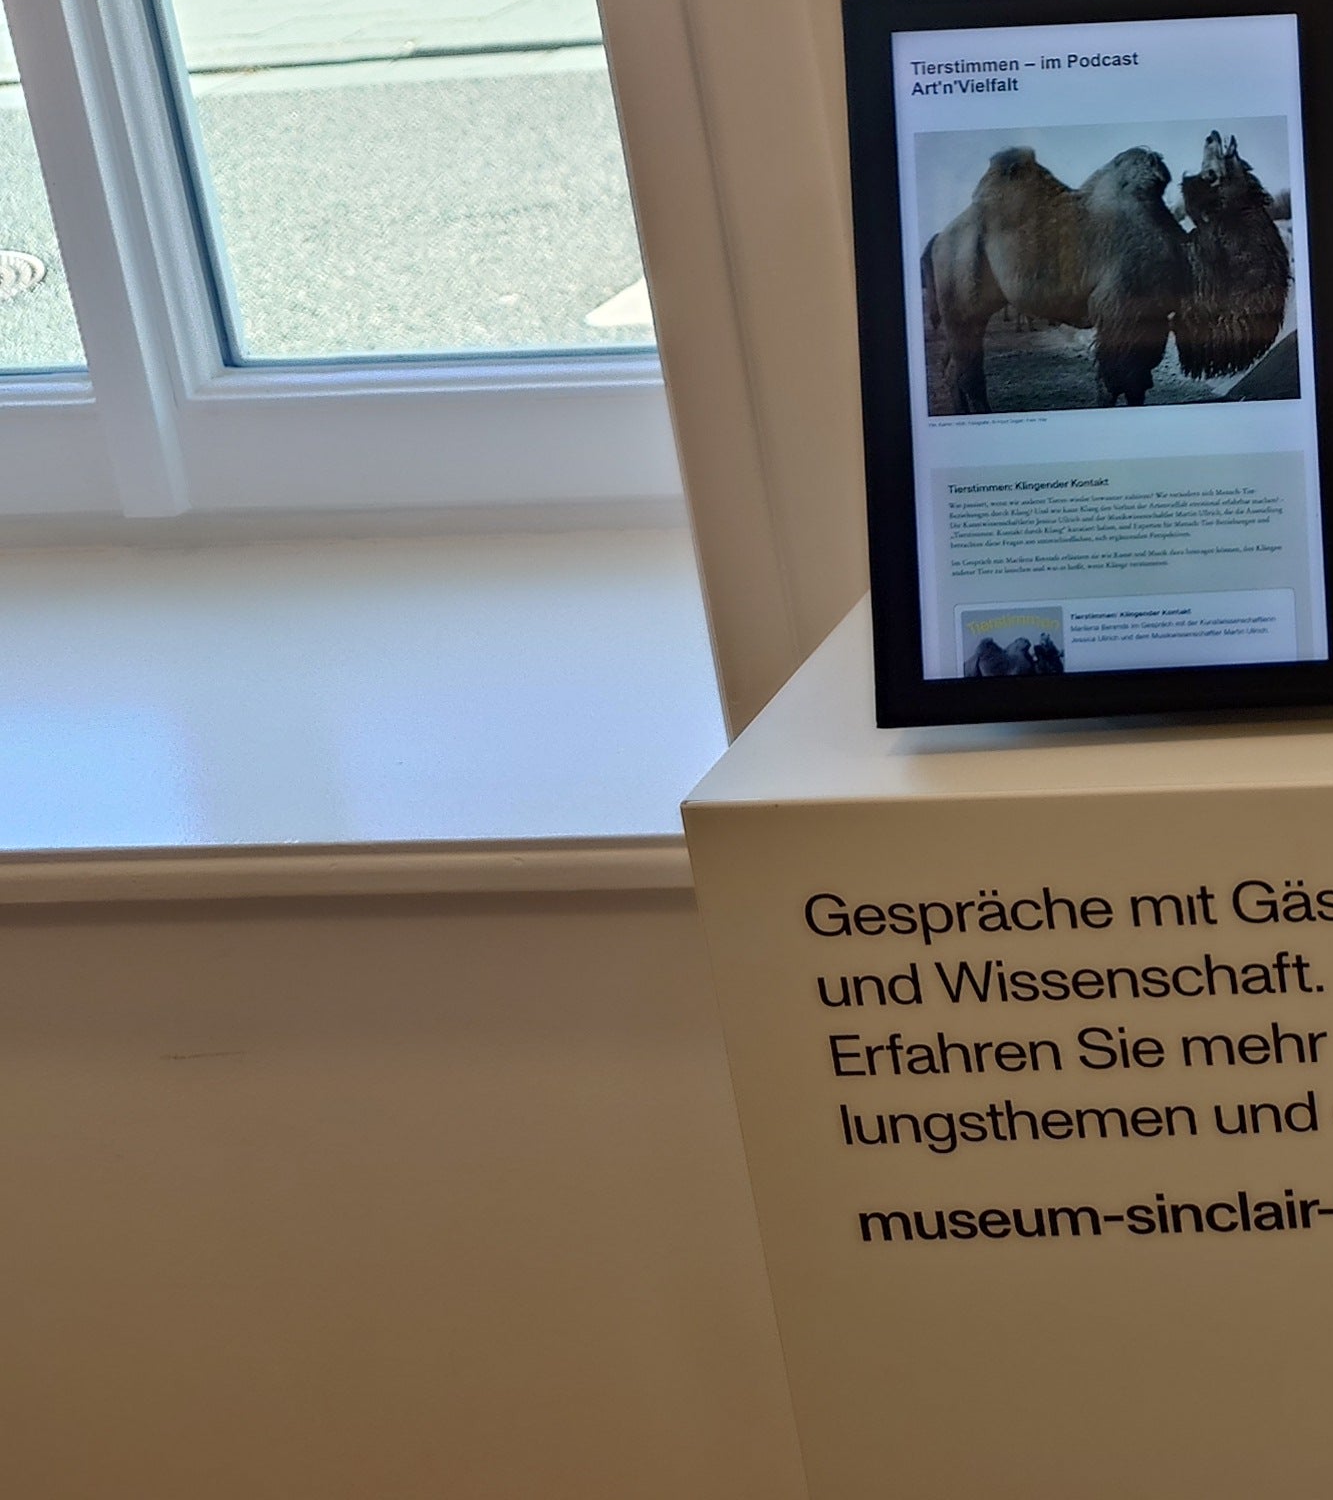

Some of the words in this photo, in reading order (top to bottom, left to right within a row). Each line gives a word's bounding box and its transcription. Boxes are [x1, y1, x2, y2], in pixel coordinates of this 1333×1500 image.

[910, 58, 1020, 76] Tierstimmen
[1040, 55, 1062, 70] im
[1067, 52, 1139, 69] Podcast
[911, 77, 1019, 96] Art'n'Vielfalt
[948, 483, 1013, 495] Tierstimmen:
[1015, 479, 1069, 491] Klingender
[1070, 477, 1109, 488] Kontakt
[804, 886, 1114, 946] Gespräche
[1130, 885, 1218, 927] mit
[817, 962, 923, 1008] und
[934, 951, 1325, 1004] Wissenschaft.
[828, 1028, 1063, 1077] Erfahren
[1077, 1026, 1165, 1070] Sie
[1181, 1022, 1328, 1067] mehr
[839, 1099, 1198, 1154] lungsthemen
[1213, 1090, 1319, 1135] und
